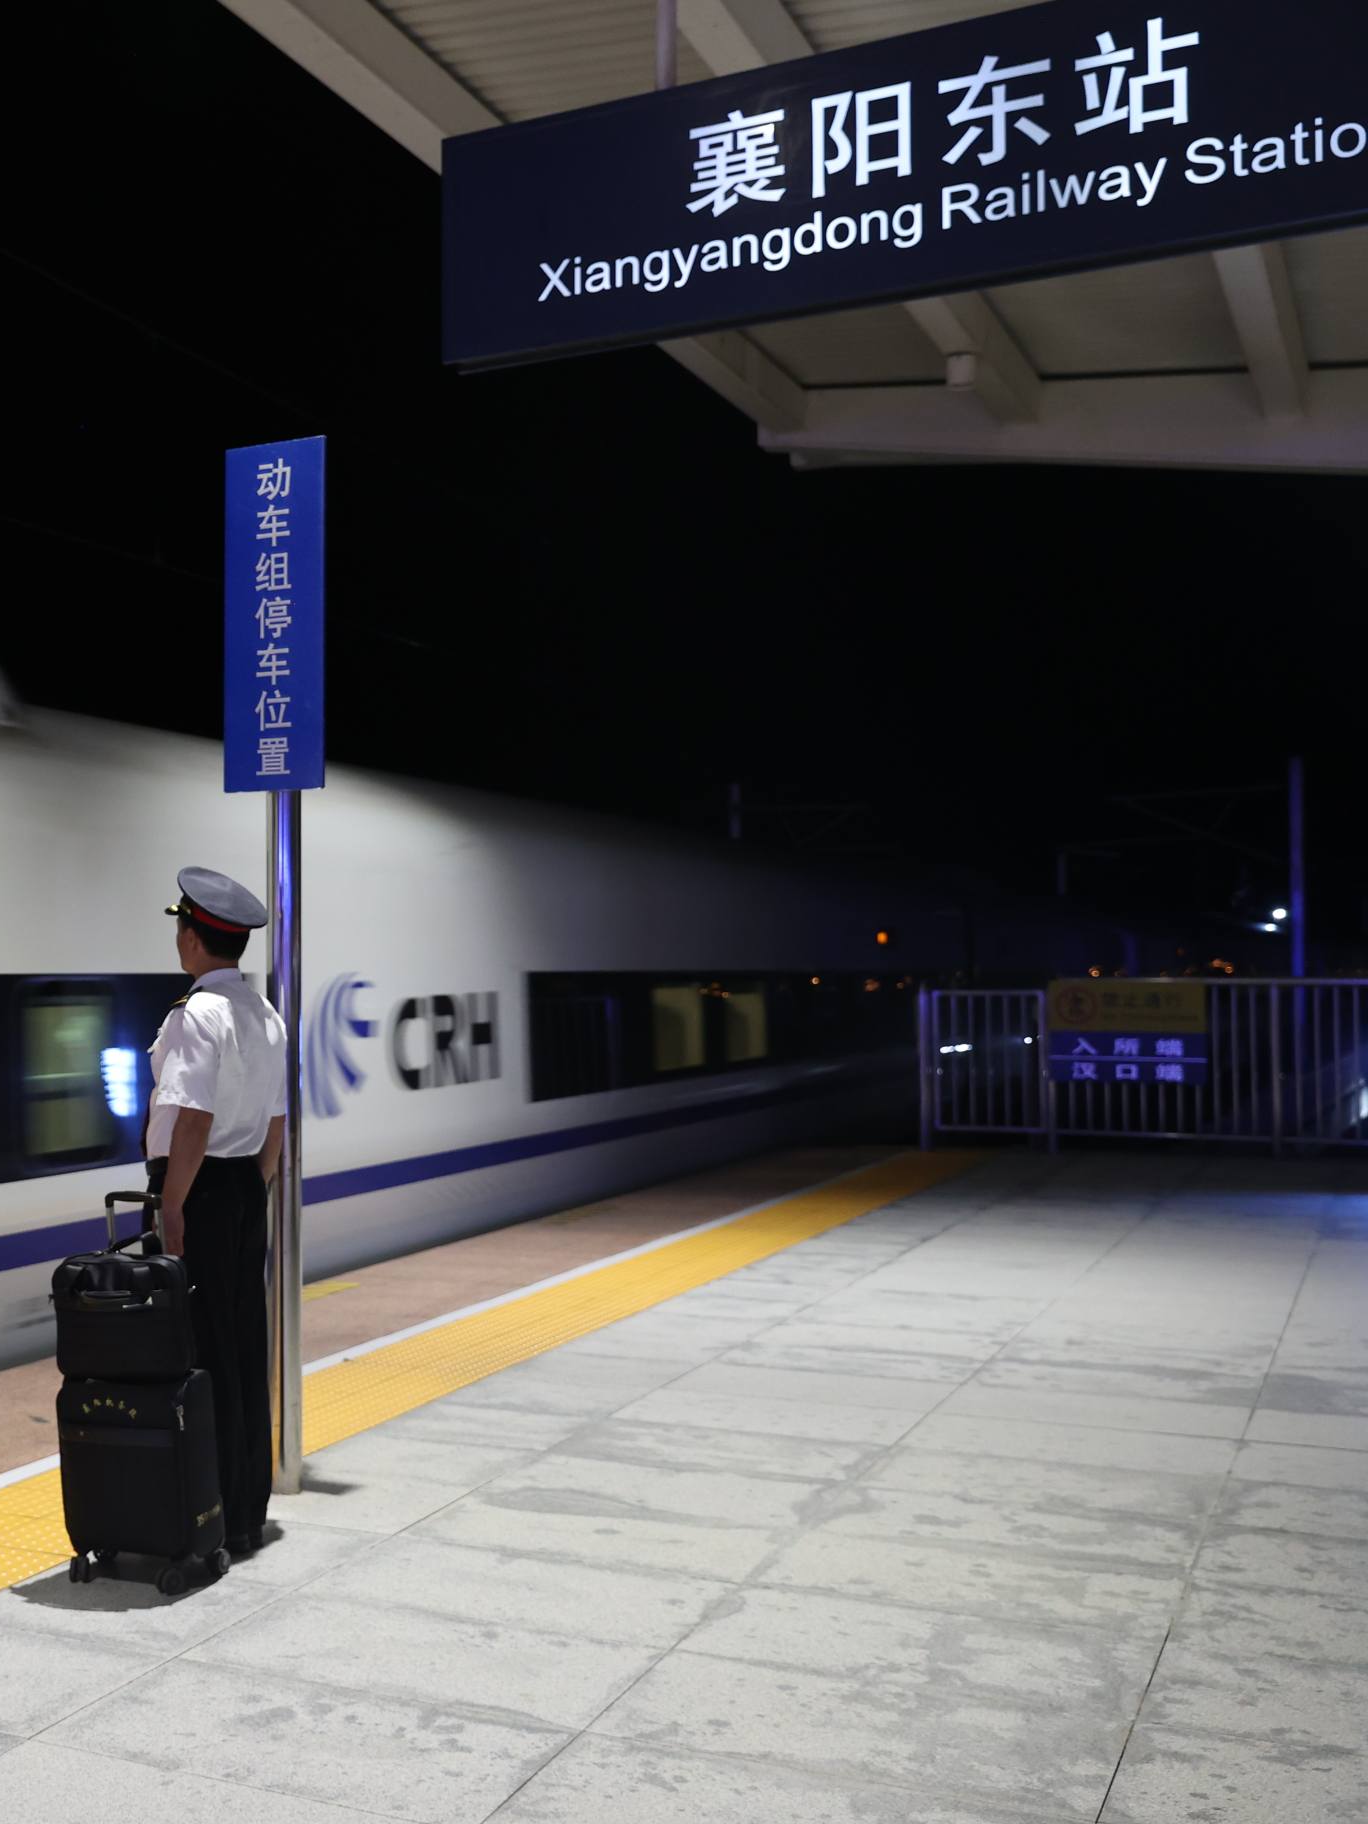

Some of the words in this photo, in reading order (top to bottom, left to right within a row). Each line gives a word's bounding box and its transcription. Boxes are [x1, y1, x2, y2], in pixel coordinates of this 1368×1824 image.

[538, 202, 923, 302] Xiangyangdong
[941, 157, 1168, 230] Railway
[1184, 117, 1367, 185] Statio
[685, 16, 1200, 218] 襄阳东站
[255, 458, 292, 777] 动车组停车位置
[389, 991, 501, 1090] CRH
